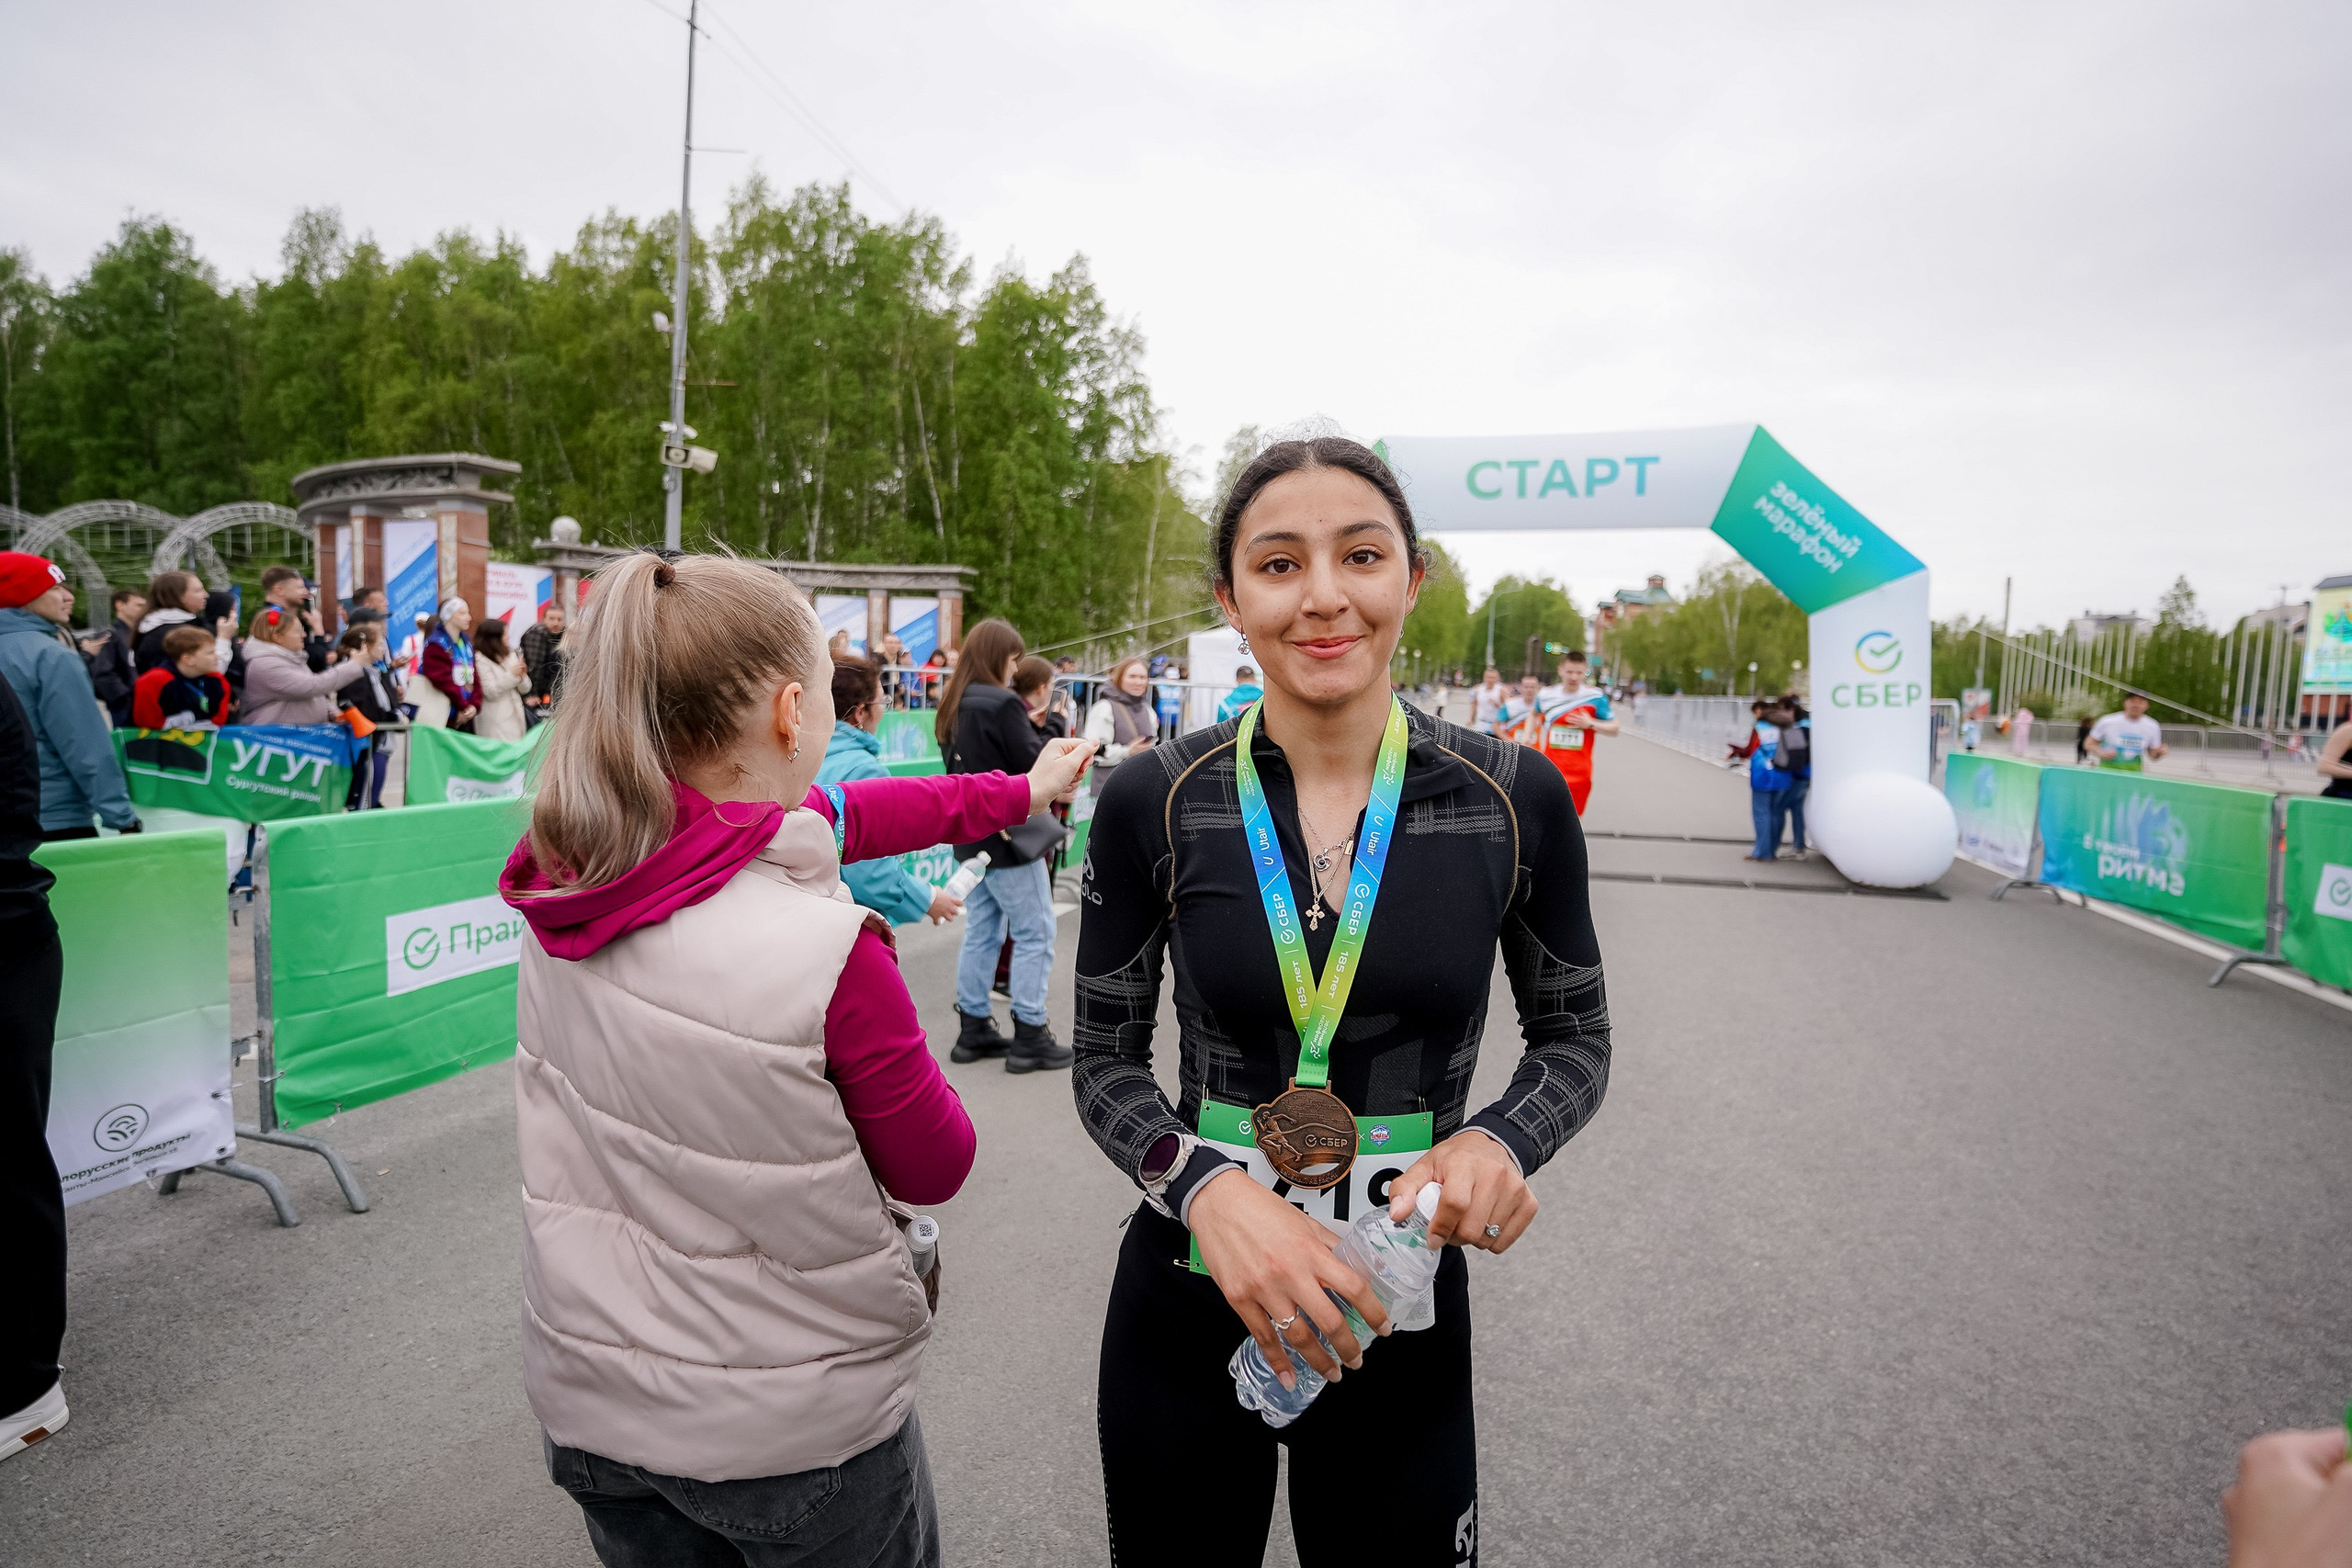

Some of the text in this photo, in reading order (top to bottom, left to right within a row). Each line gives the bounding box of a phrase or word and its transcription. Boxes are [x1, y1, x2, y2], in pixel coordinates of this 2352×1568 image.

[1466, 457, 1659, 500] СТАРТ
[1753, 495, 1843, 574] марафон
[1770, 480, 1863, 558] зелёный
[1831, 682, 1922, 708] СБЕР
[230, 738, 334, 788] УГУТ
[1257, 827, 1270, 851] Utair
[1367, 831, 1381, 856] Utair
[1273, 893, 1289, 927] СБЕР
[1348, 901, 1363, 936] СБЕР
[1292, 960, 1308, 1009] 185 лет
[1329, 950, 1349, 998] 185 лет
[131, 1134, 191, 1158] продукты
[1319, 1137, 1348, 1148] СБЕР
